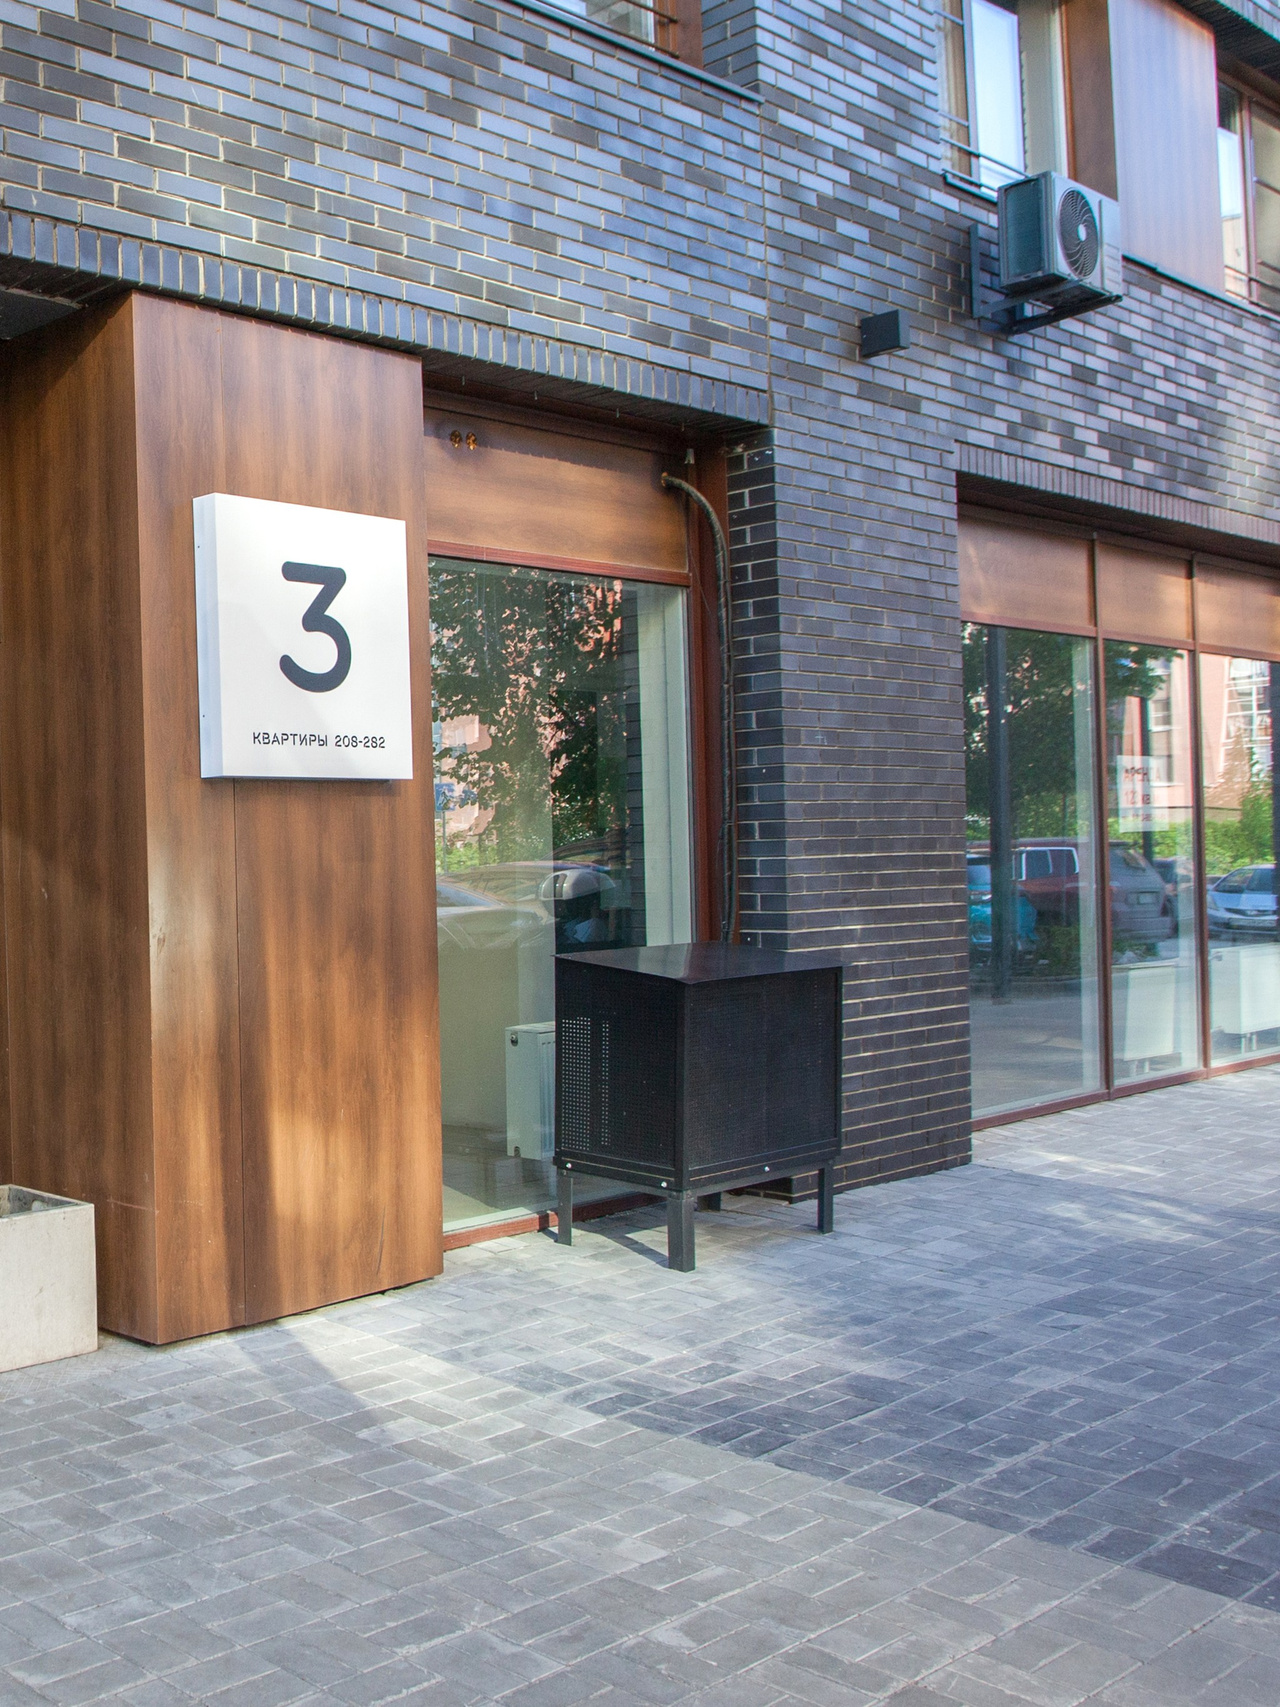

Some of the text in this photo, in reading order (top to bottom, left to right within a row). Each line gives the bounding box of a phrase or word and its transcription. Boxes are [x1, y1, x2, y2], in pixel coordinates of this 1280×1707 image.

[279, 561, 352, 693] 3
[252, 731, 386, 749] КВАРТИРЫ 208-282
